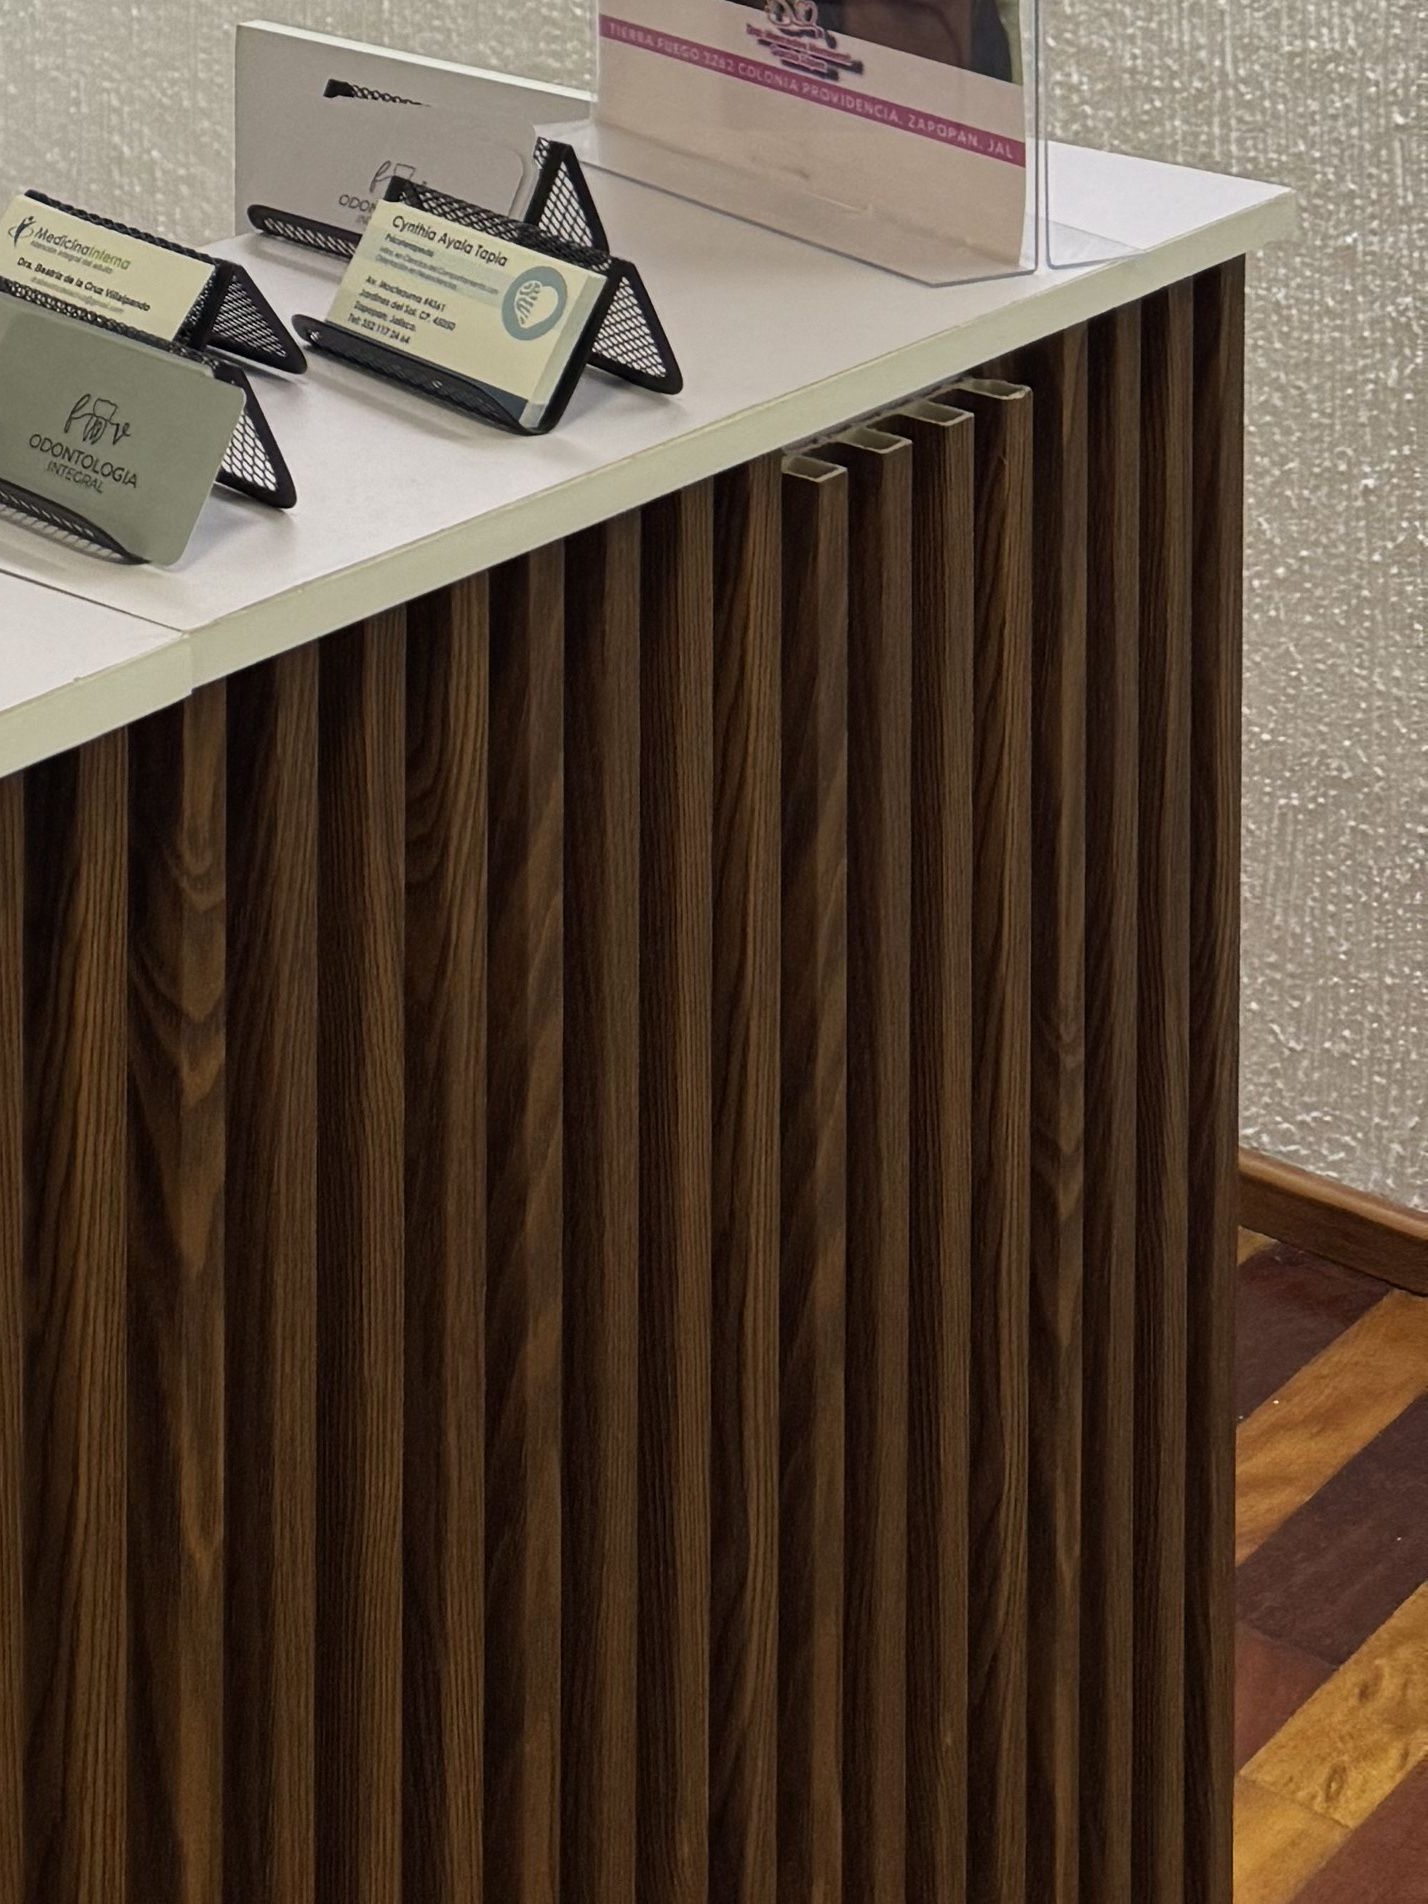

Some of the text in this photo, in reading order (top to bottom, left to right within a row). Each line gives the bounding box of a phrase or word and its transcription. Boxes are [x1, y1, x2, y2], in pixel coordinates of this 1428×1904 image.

[609, 22, 655, 46] TIERRA
[738, 63, 799, 91] COLONIA
[392, 215, 508, 267] Cynthia Ayala Tapia
[29, 434, 137, 489] ODONTOLOGIA
[46, 460, 103, 495] INTEGRAL
